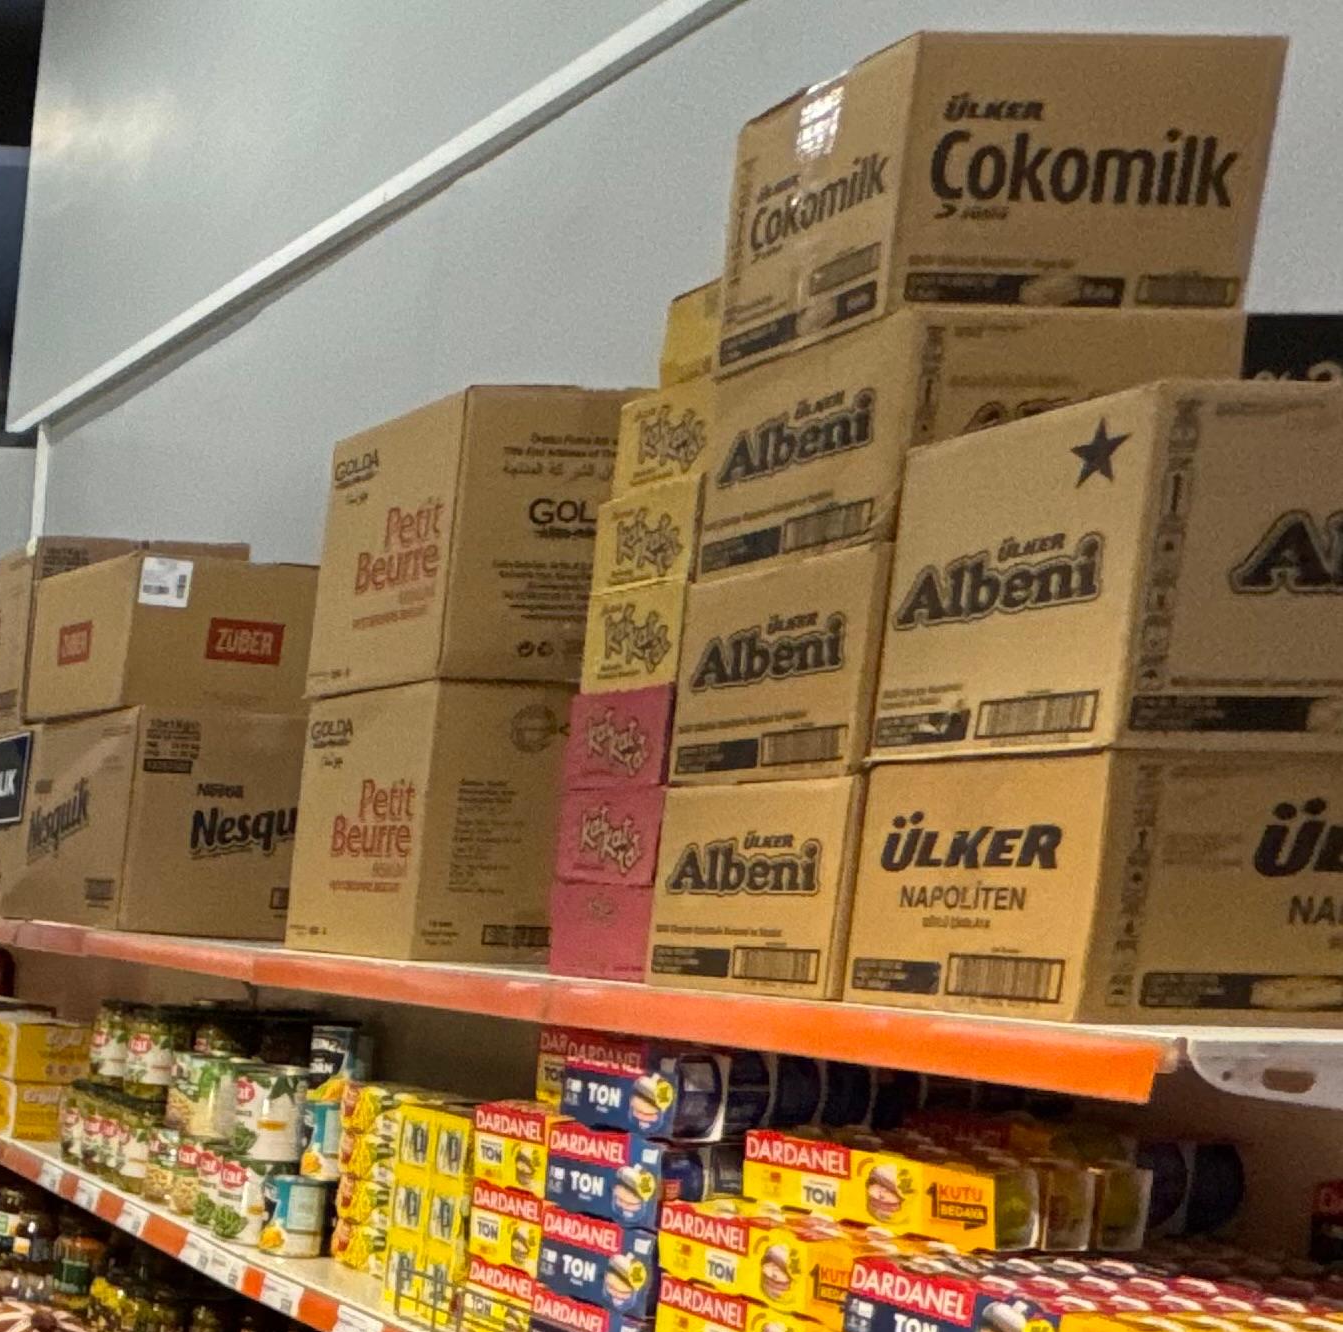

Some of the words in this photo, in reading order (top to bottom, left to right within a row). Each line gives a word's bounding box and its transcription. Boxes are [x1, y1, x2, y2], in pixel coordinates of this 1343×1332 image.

[943, 94, 1045, 122] ÜLKER
[717, 388, 875, 488] Albeni
[335, 448, 380, 481] GOLDA
[384, 496, 444, 551] Petit
[529, 498, 598, 524] GOL
[998, 533, 1066, 562] ÜLKER
[355, 544, 440, 595] Beurre
[893, 531, 1104, 631] Albeni
[767, 612, 818, 636] ÜLKER
[690, 611, 846, 693] Albeni
[312, 718, 354, 740] GOLDA
[27, 776, 90, 855] Nesquik
[358, 777, 417, 821] Petit
[190, 806, 298, 856] Nesqu
[330, 814, 412, 857] Beurre
[743, 830, 795, 851] ÜLKER
[880, 811, 1063, 872] ÜLKER
[666, 838, 822, 896] Albeni
[899, 880, 1027, 912] NAPOLİTEN
[587, 1081, 622, 1108] TON
[476, 1110, 543, 1142] DARDANEL
[481, 1144, 502, 1163] TON
[550, 1130, 626, 1165] DARDANEL
[746, 1135, 849, 1177] DARDANEL
[569, 1170, 605, 1198] TON
[803, 1185, 837, 1208] TON
[938, 1183, 984, 1203] KUTU
[473, 1186, 540, 1222] DARDANEL
[939, 1205, 987, 1221] BEDAVA
[477, 1220, 498, 1241] TON
[544, 1213, 620, 1252] DARDANEL
[662, 1207, 747, 1254] DARDANEL
[470, 1261, 533, 1299] DARDANEL
[562, 1253, 597, 1282] TON
[707, 1258, 735, 1283] TON
[821, 1267, 850, 1287] KUT
[661, 1281, 745, 1329] DARDANEL
[850, 1263, 969, 1321] DARDANEL
